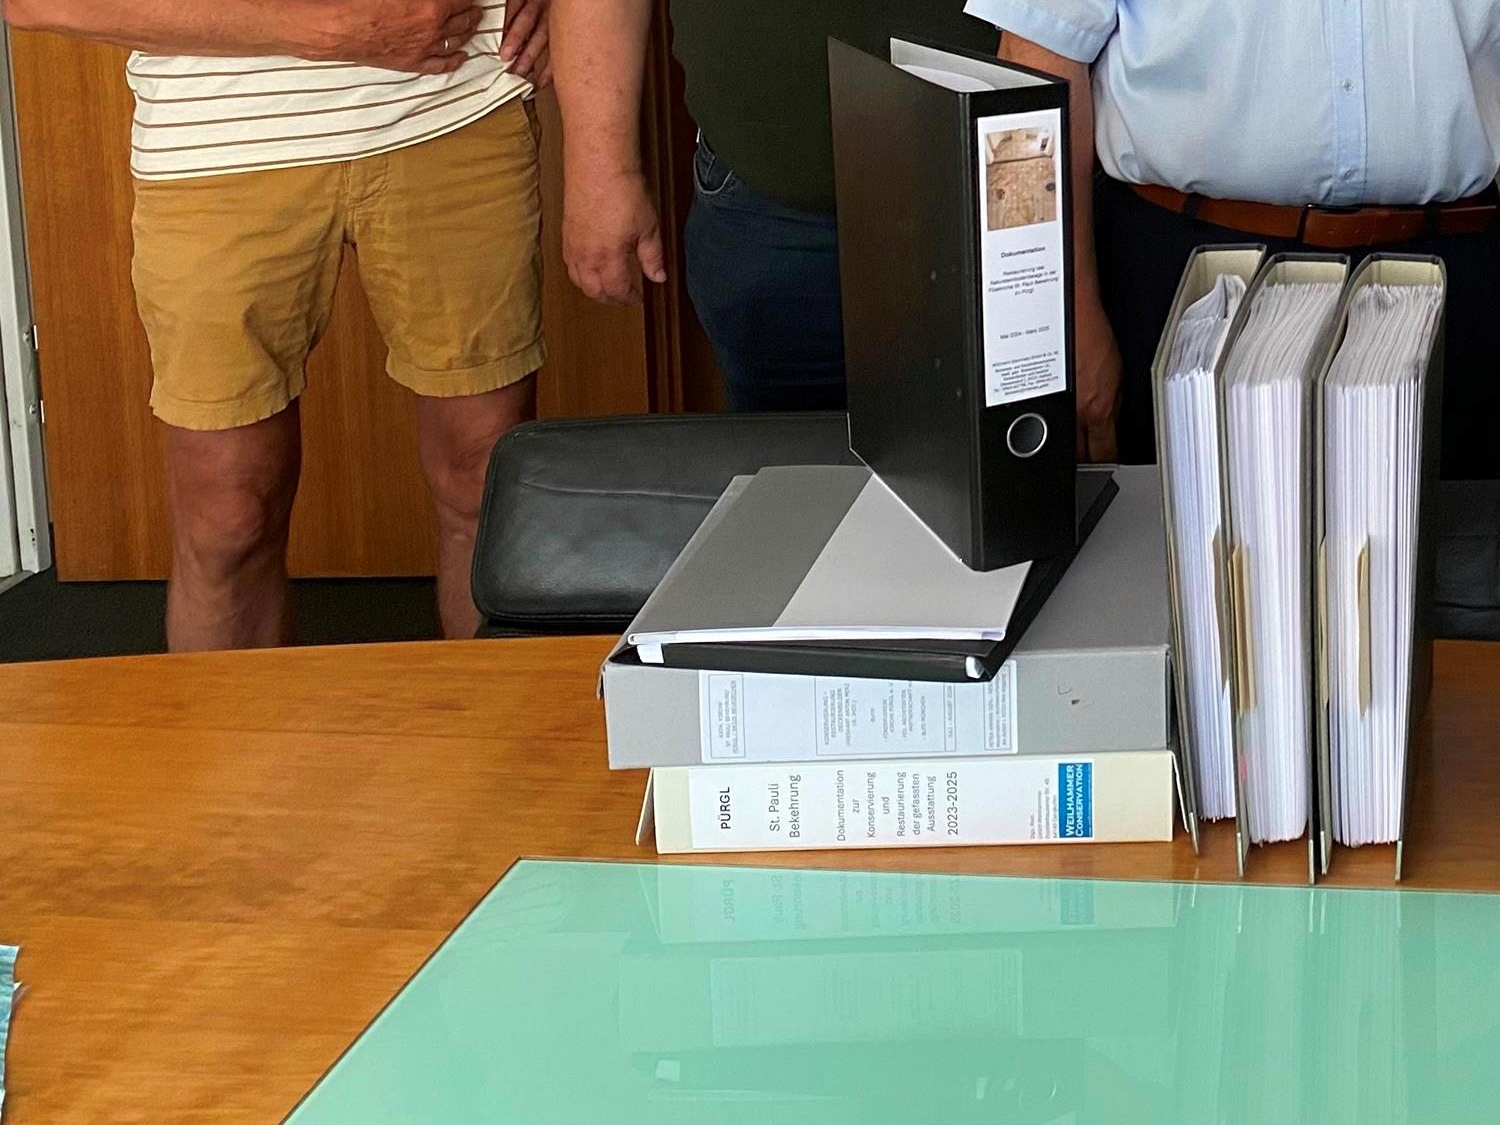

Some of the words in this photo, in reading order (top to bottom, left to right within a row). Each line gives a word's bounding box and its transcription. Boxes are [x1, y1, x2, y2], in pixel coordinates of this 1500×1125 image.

[718, 786, 731, 830] PÜRGL
[768, 783, 779, 812] Pauli
[769, 816, 780, 831] St.
[788, 774, 801, 838] Bekehrung
[836, 770, 846, 842] Dokumentation
[852, 798, 860, 814] zur
[866, 771, 876, 838] Konservierung
[881, 796, 890, 815] und
[896, 771, 907, 837] Restaurierung
[912, 773, 922, 818] gefassten
[926, 775, 936, 832] Ausstattung
[946, 771, 959, 835] 2023-2025
[1065, 765, 1075, 836] WEILHAMMER
[1075, 764, 1084, 837] CONSERVATION
[911, 820, 921, 836] der
